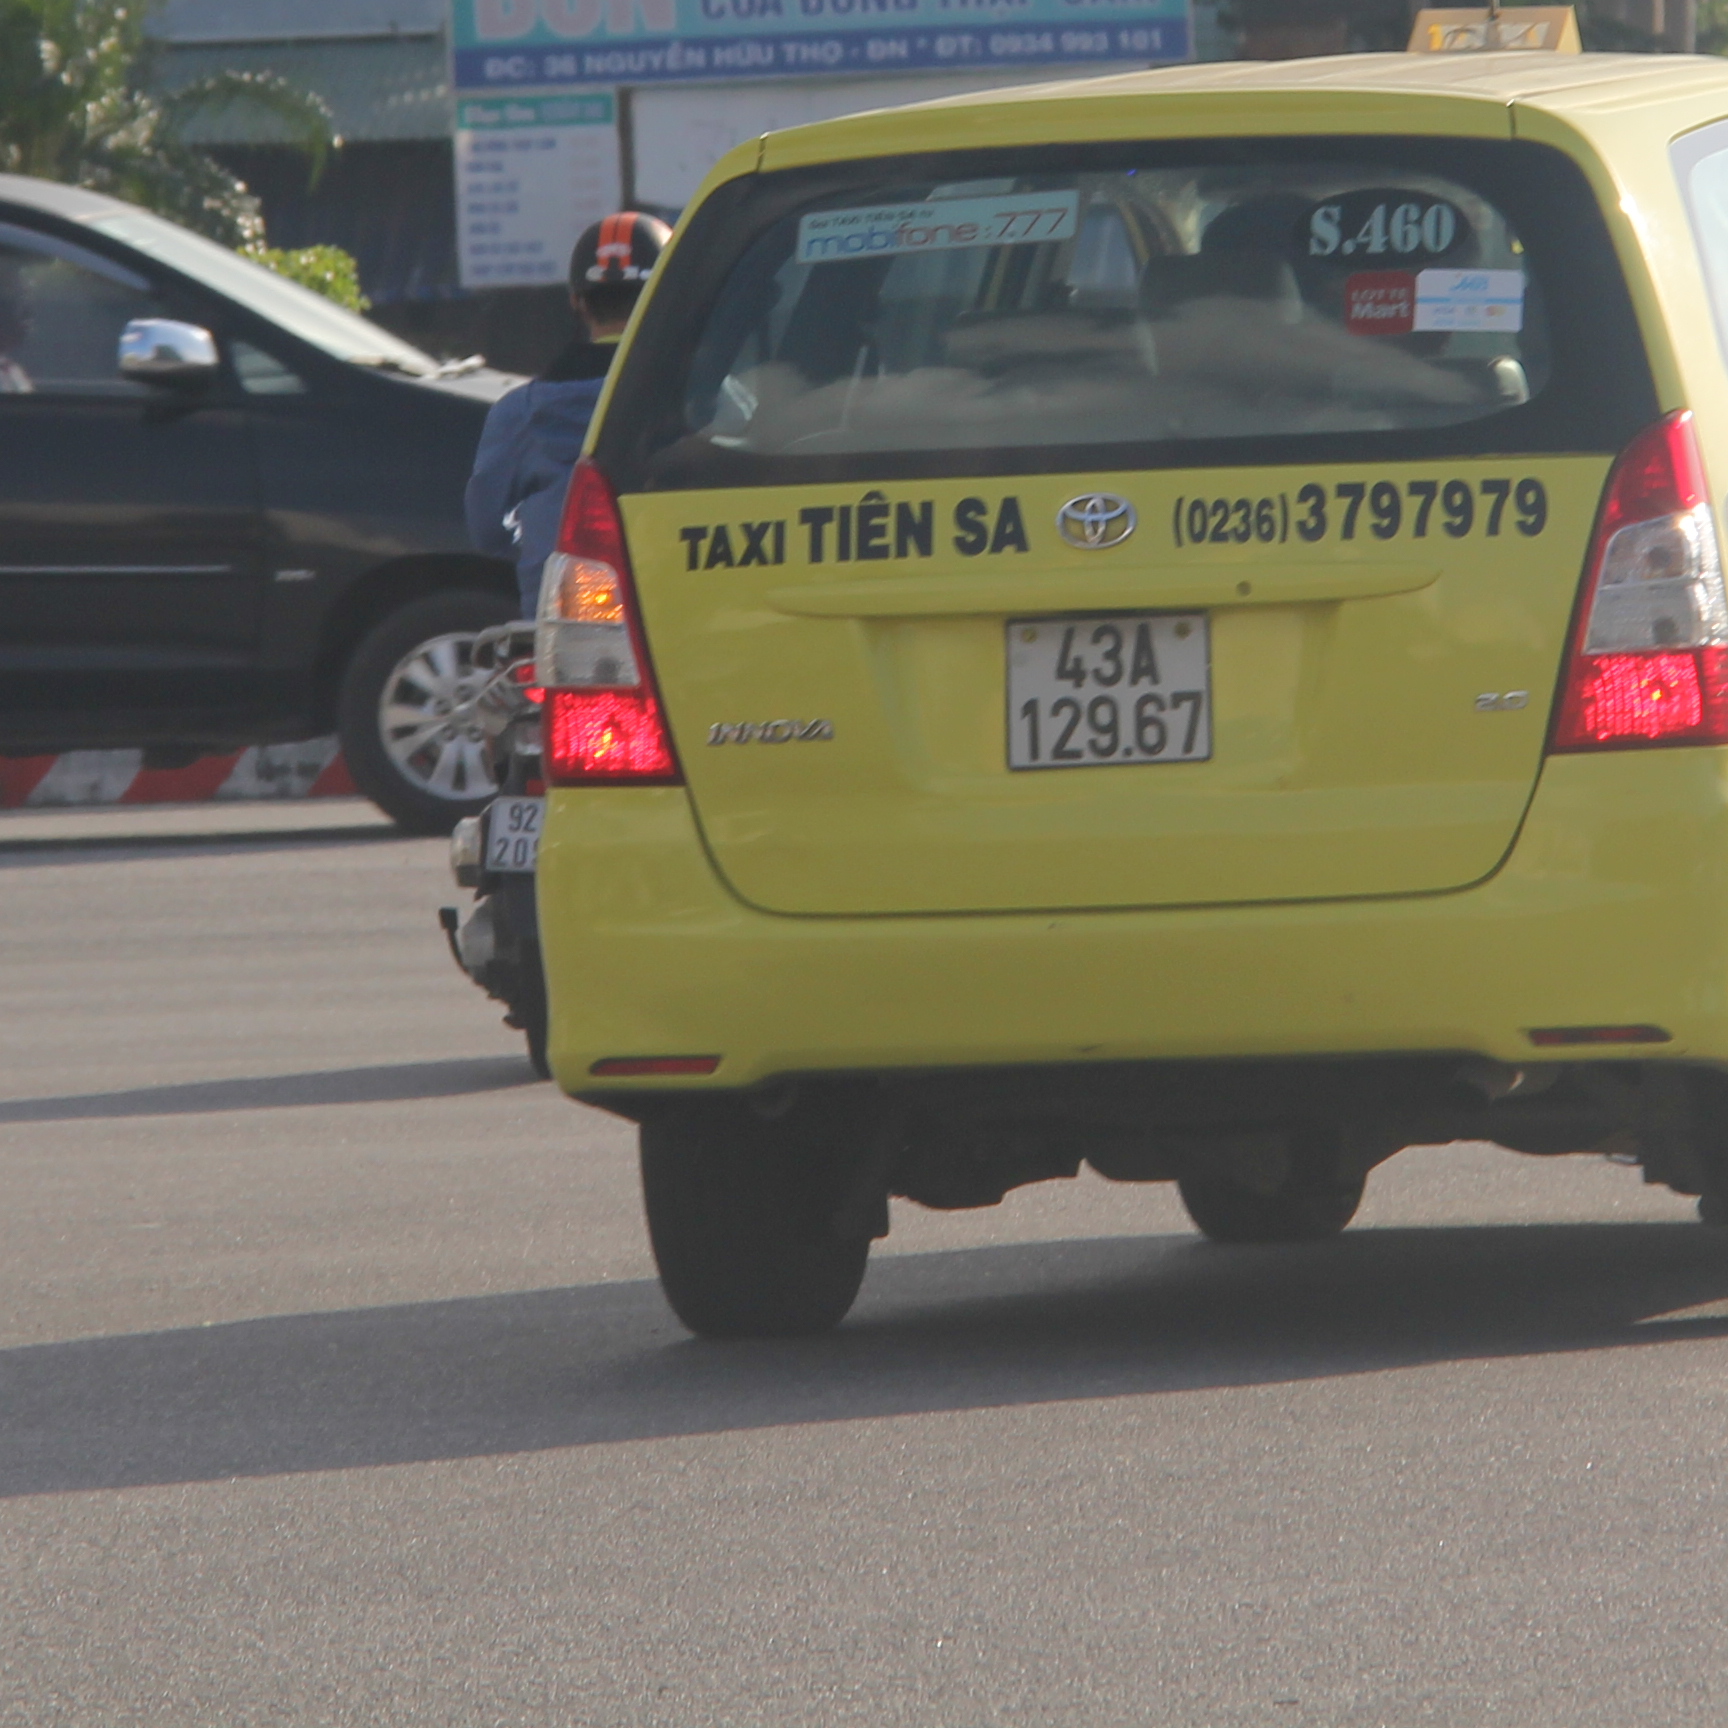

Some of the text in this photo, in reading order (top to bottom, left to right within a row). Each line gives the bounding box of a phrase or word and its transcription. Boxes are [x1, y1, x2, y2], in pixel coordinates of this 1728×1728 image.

[1308, 202, 1456, 256] S.460
[1350, 301, 1411, 320] Mart
[679, 489, 1031, 571] TAXI TIÊN SA
[1056, 622, 1161, 688] 43A
[1021, 690, 1203, 762] 129.67
[506, 802, 539, 833] 92
